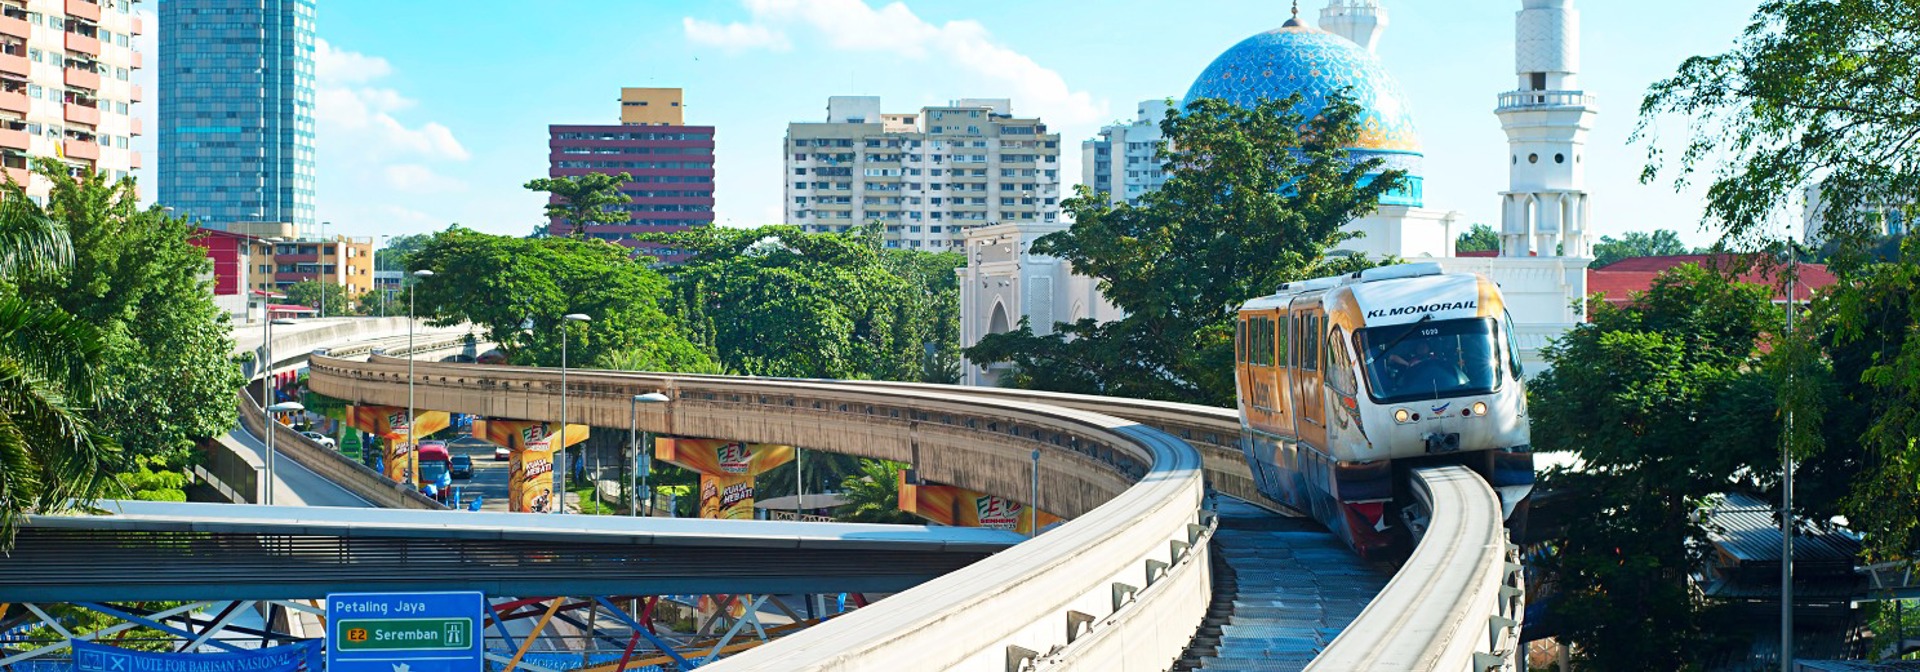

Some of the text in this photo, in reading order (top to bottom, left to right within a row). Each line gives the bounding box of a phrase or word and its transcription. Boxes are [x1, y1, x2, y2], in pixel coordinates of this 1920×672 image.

[1367, 301, 1477, 318] KL MONORAIL
[336, 601, 426, 614] Petaling Jaya
[350, 629, 438, 640] E2 Seremban
[134, 653, 290, 672] VOTE FOR BARISAN NASIONAL
